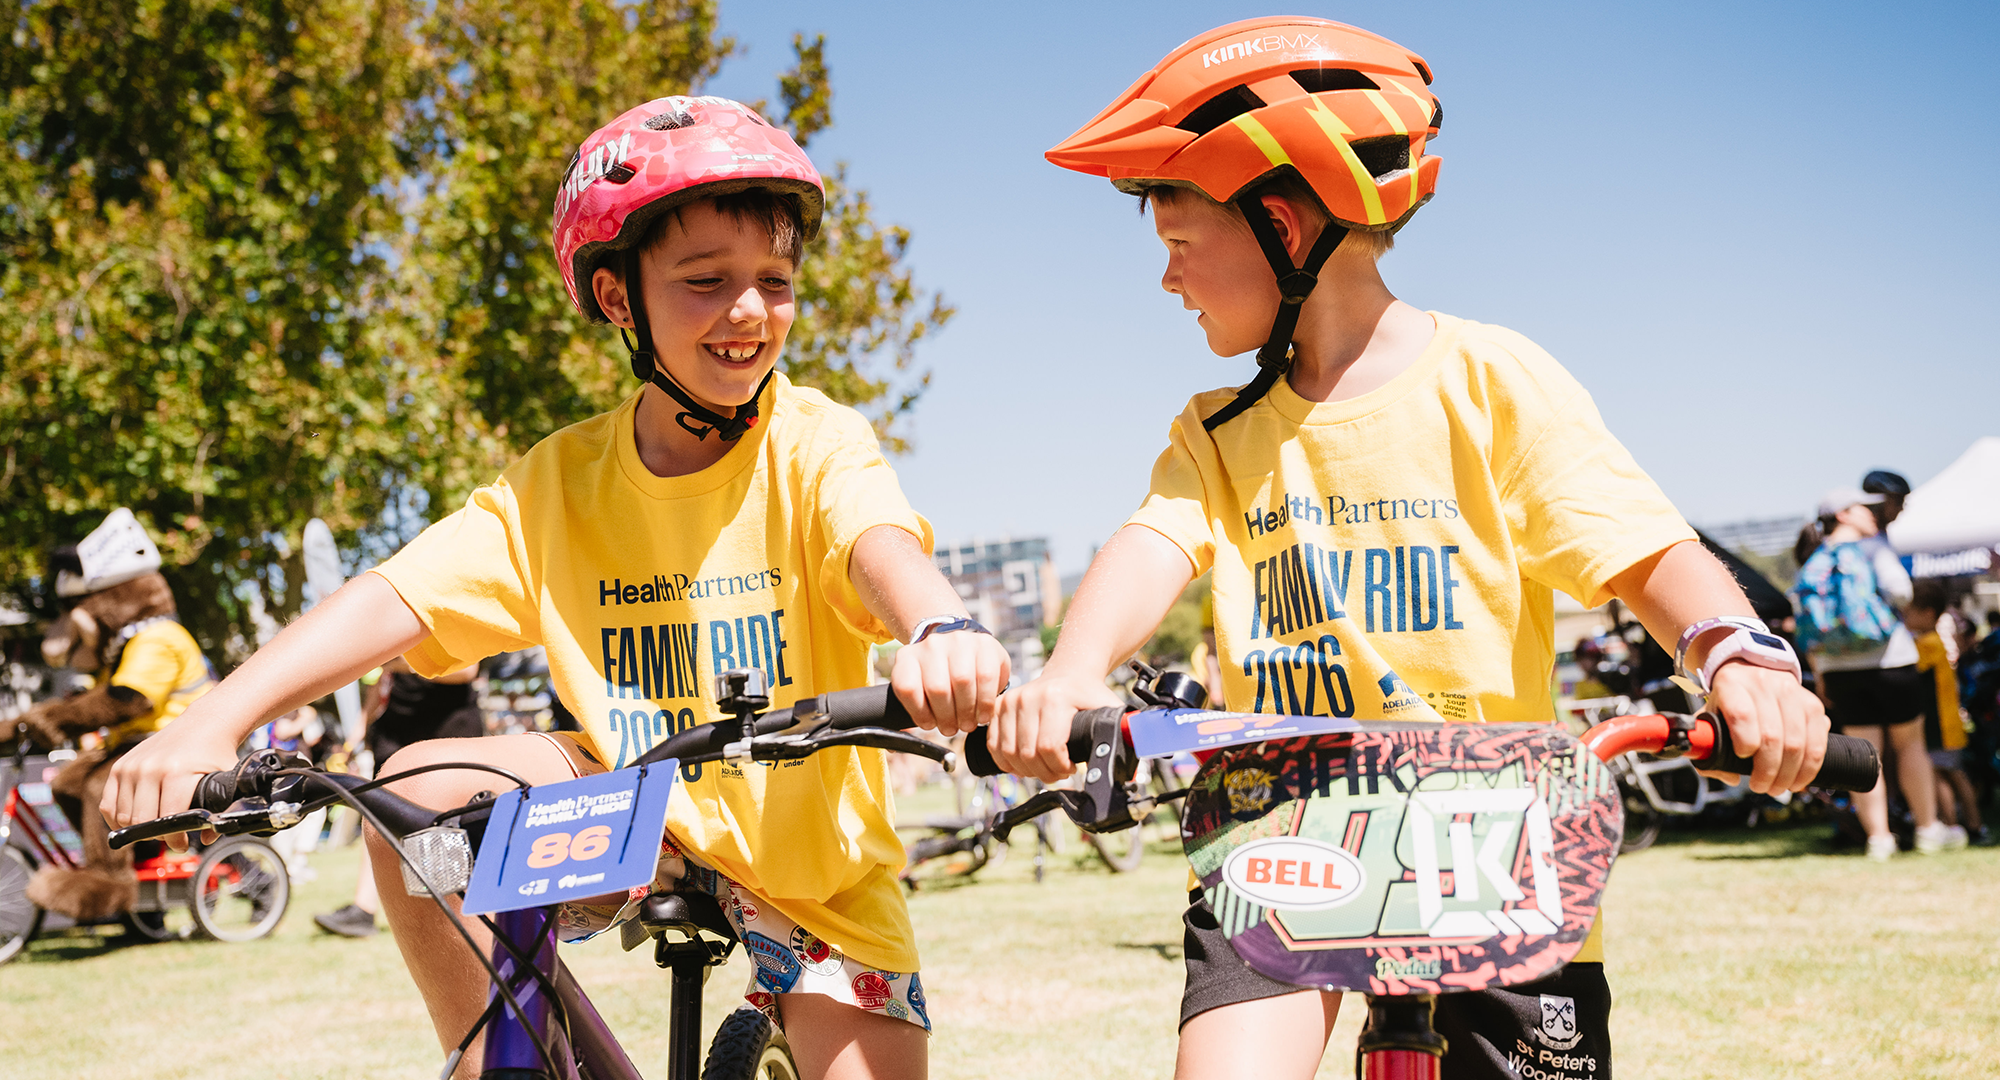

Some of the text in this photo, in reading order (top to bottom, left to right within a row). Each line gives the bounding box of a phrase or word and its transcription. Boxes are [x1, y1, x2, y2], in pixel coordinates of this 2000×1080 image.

[1250, 543, 1464, 640] FAMILY RIDE
[601, 608, 793, 700] FAMILY RIDE
[1243, 634, 1355, 719] 2026
[1440, 692, 1467, 700] Santos
[1443, 704, 1467, 713] down
[1442, 710, 1468, 719] under
[525, 799, 632, 829] FAMILY RIDE
[526, 825, 613, 869] 86
[1246, 857, 1342, 890] BELL
[750, 939, 792, 966] SARDINES
[1378, 958, 1441, 980] Pedal
[876, 997, 888, 1005] TIM
[1516, 1039, 1596, 1072] St Peter's
